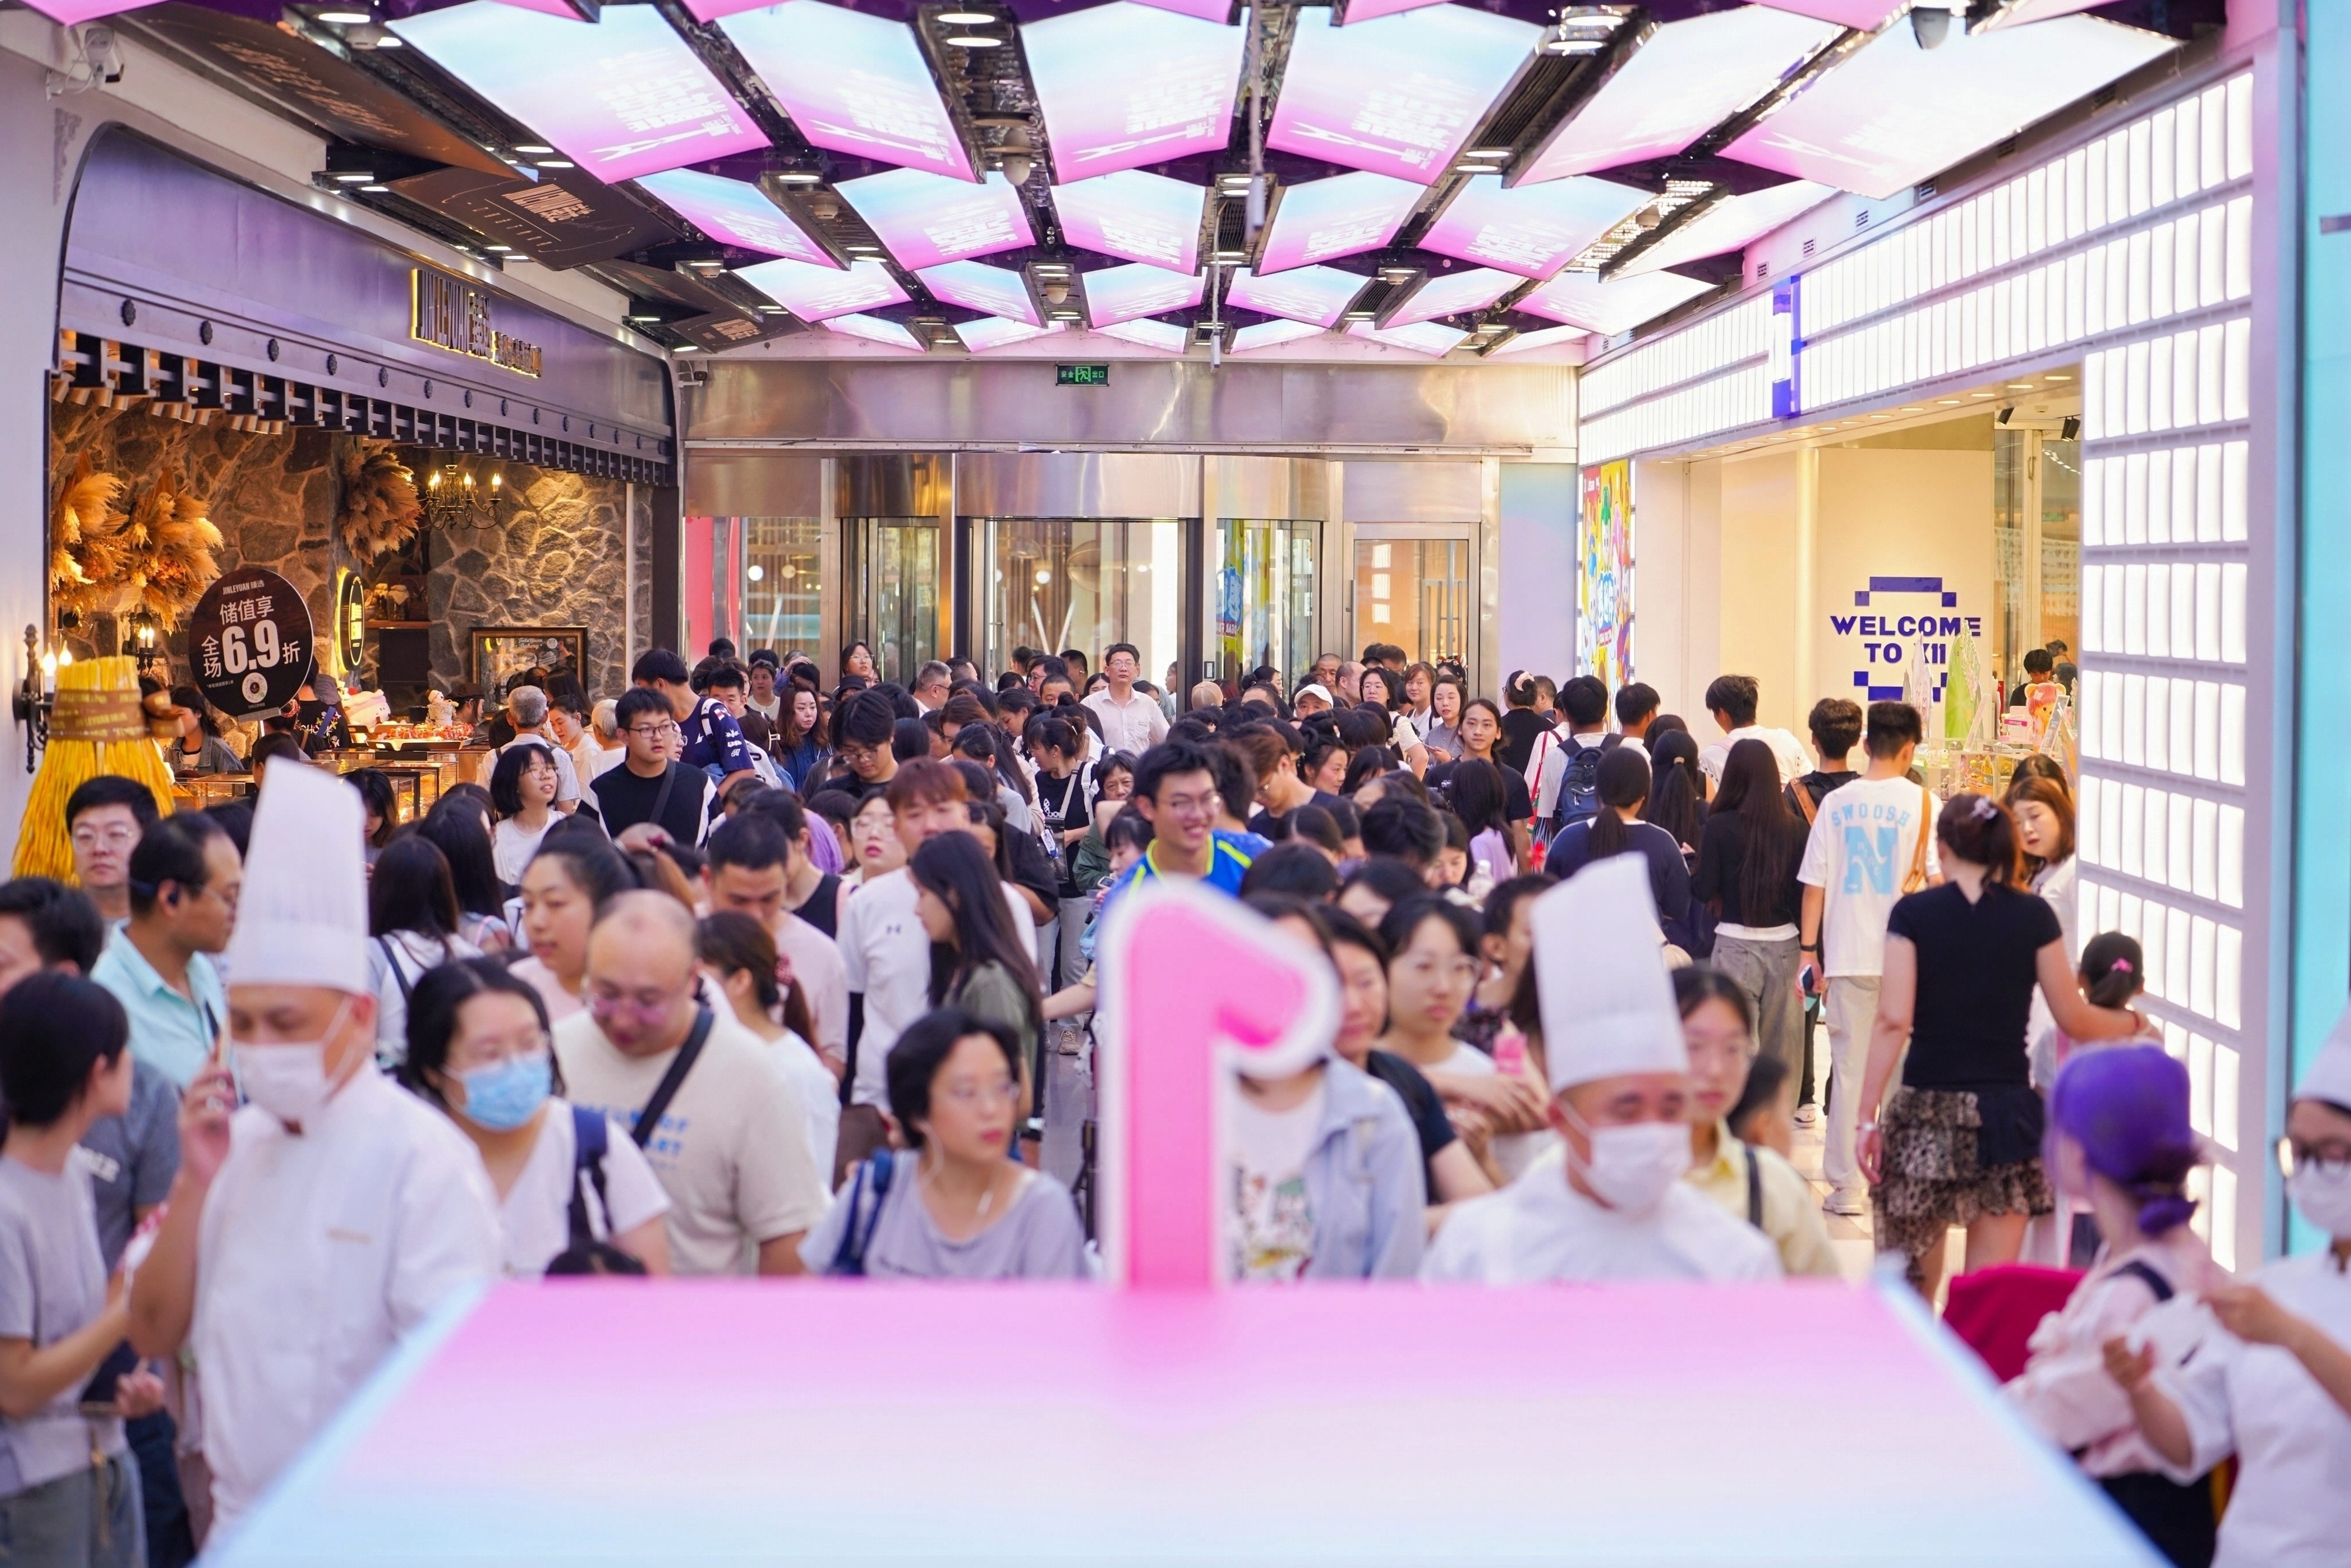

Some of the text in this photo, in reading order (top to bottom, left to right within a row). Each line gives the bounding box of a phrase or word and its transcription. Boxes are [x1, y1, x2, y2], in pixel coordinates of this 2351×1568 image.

[223, 583, 250, 595] JINLEYUAN
[220, 596, 274, 625] 储值享
[1830, 615, 1981, 637] WELCOME
[201, 619, 300, 678] 全场 6.9 折
[1864, 643, 1902, 663] TO
[1831, 803, 1910, 827] SWOOSH
